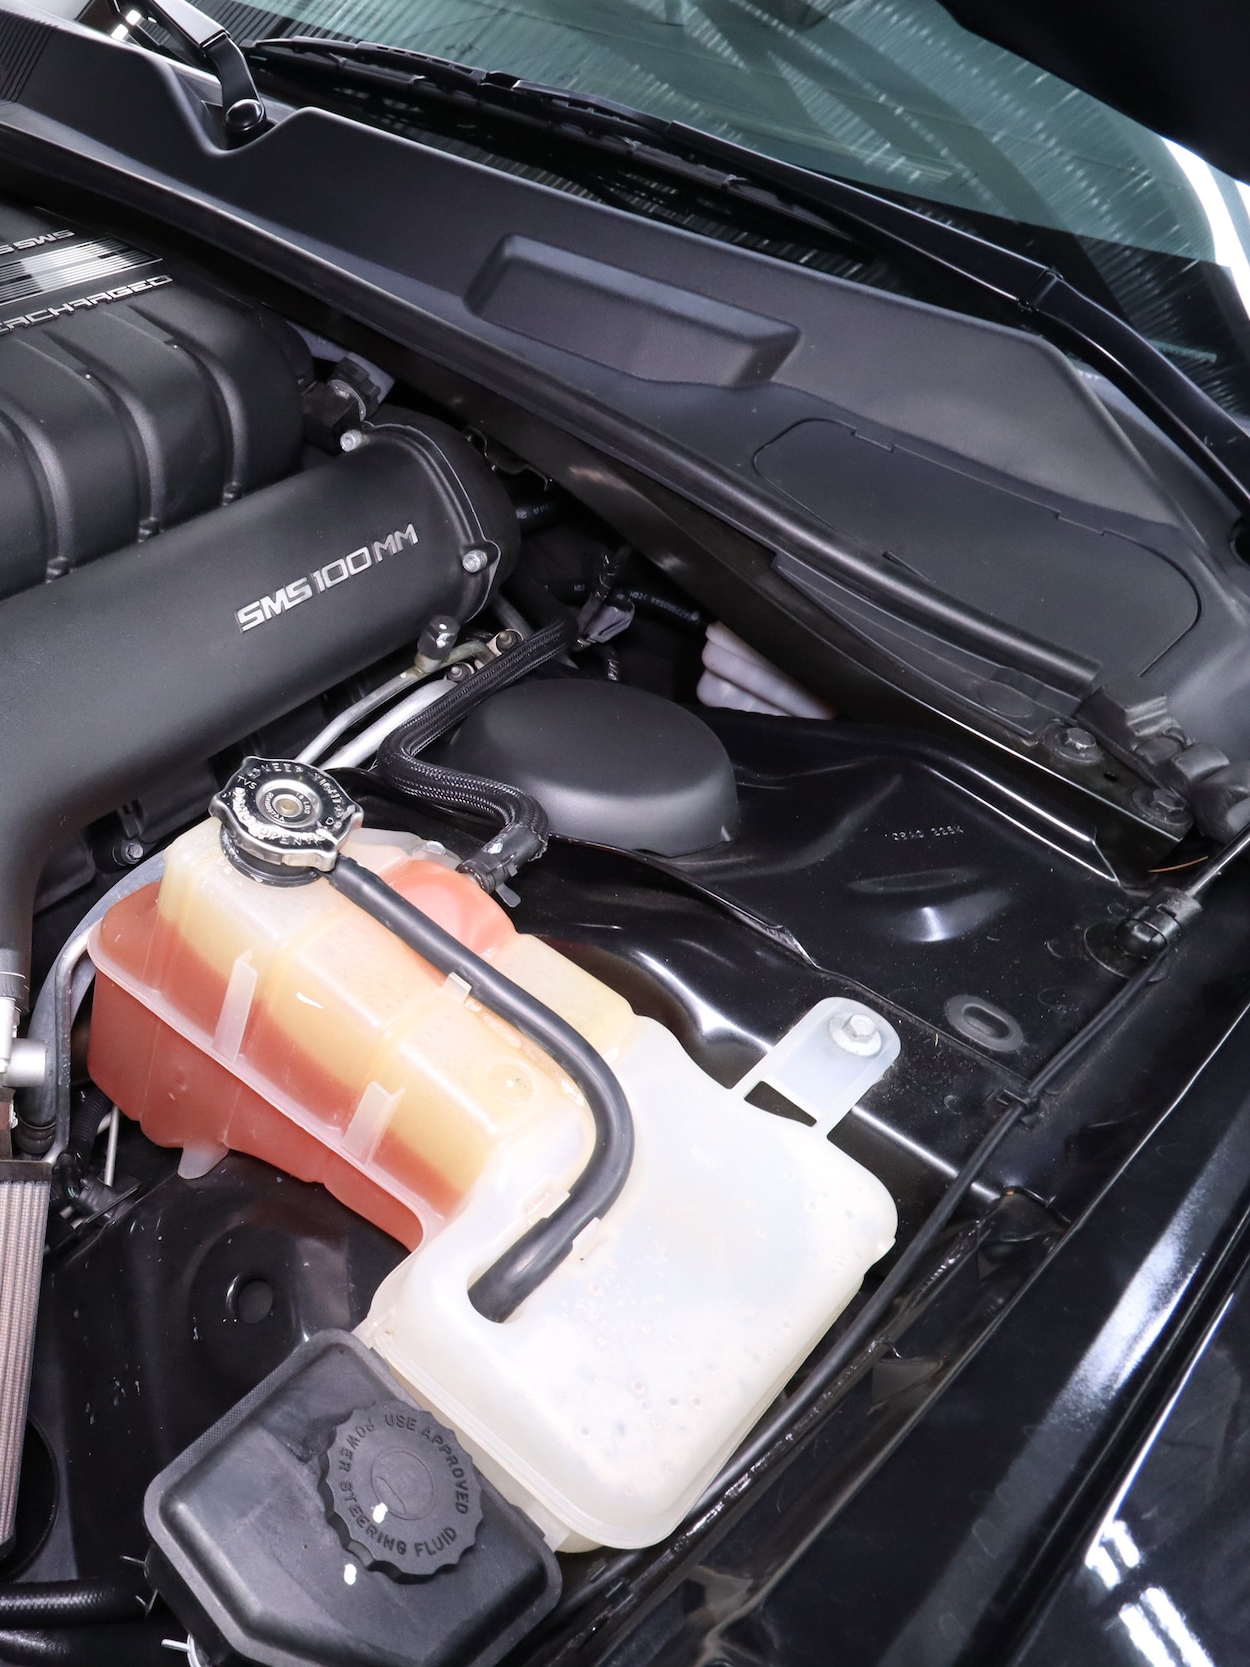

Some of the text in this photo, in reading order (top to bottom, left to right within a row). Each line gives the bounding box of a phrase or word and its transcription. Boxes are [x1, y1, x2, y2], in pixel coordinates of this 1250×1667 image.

[13, 229, 75, 250] SMS
[235, 523, 419, 633] SMS 100 MM
[237, 776, 257, 790] TVS
[338, 1419, 458, 1558] POWER STEERING FLUID
[384, 1413, 470, 1515] USE APPROVED
